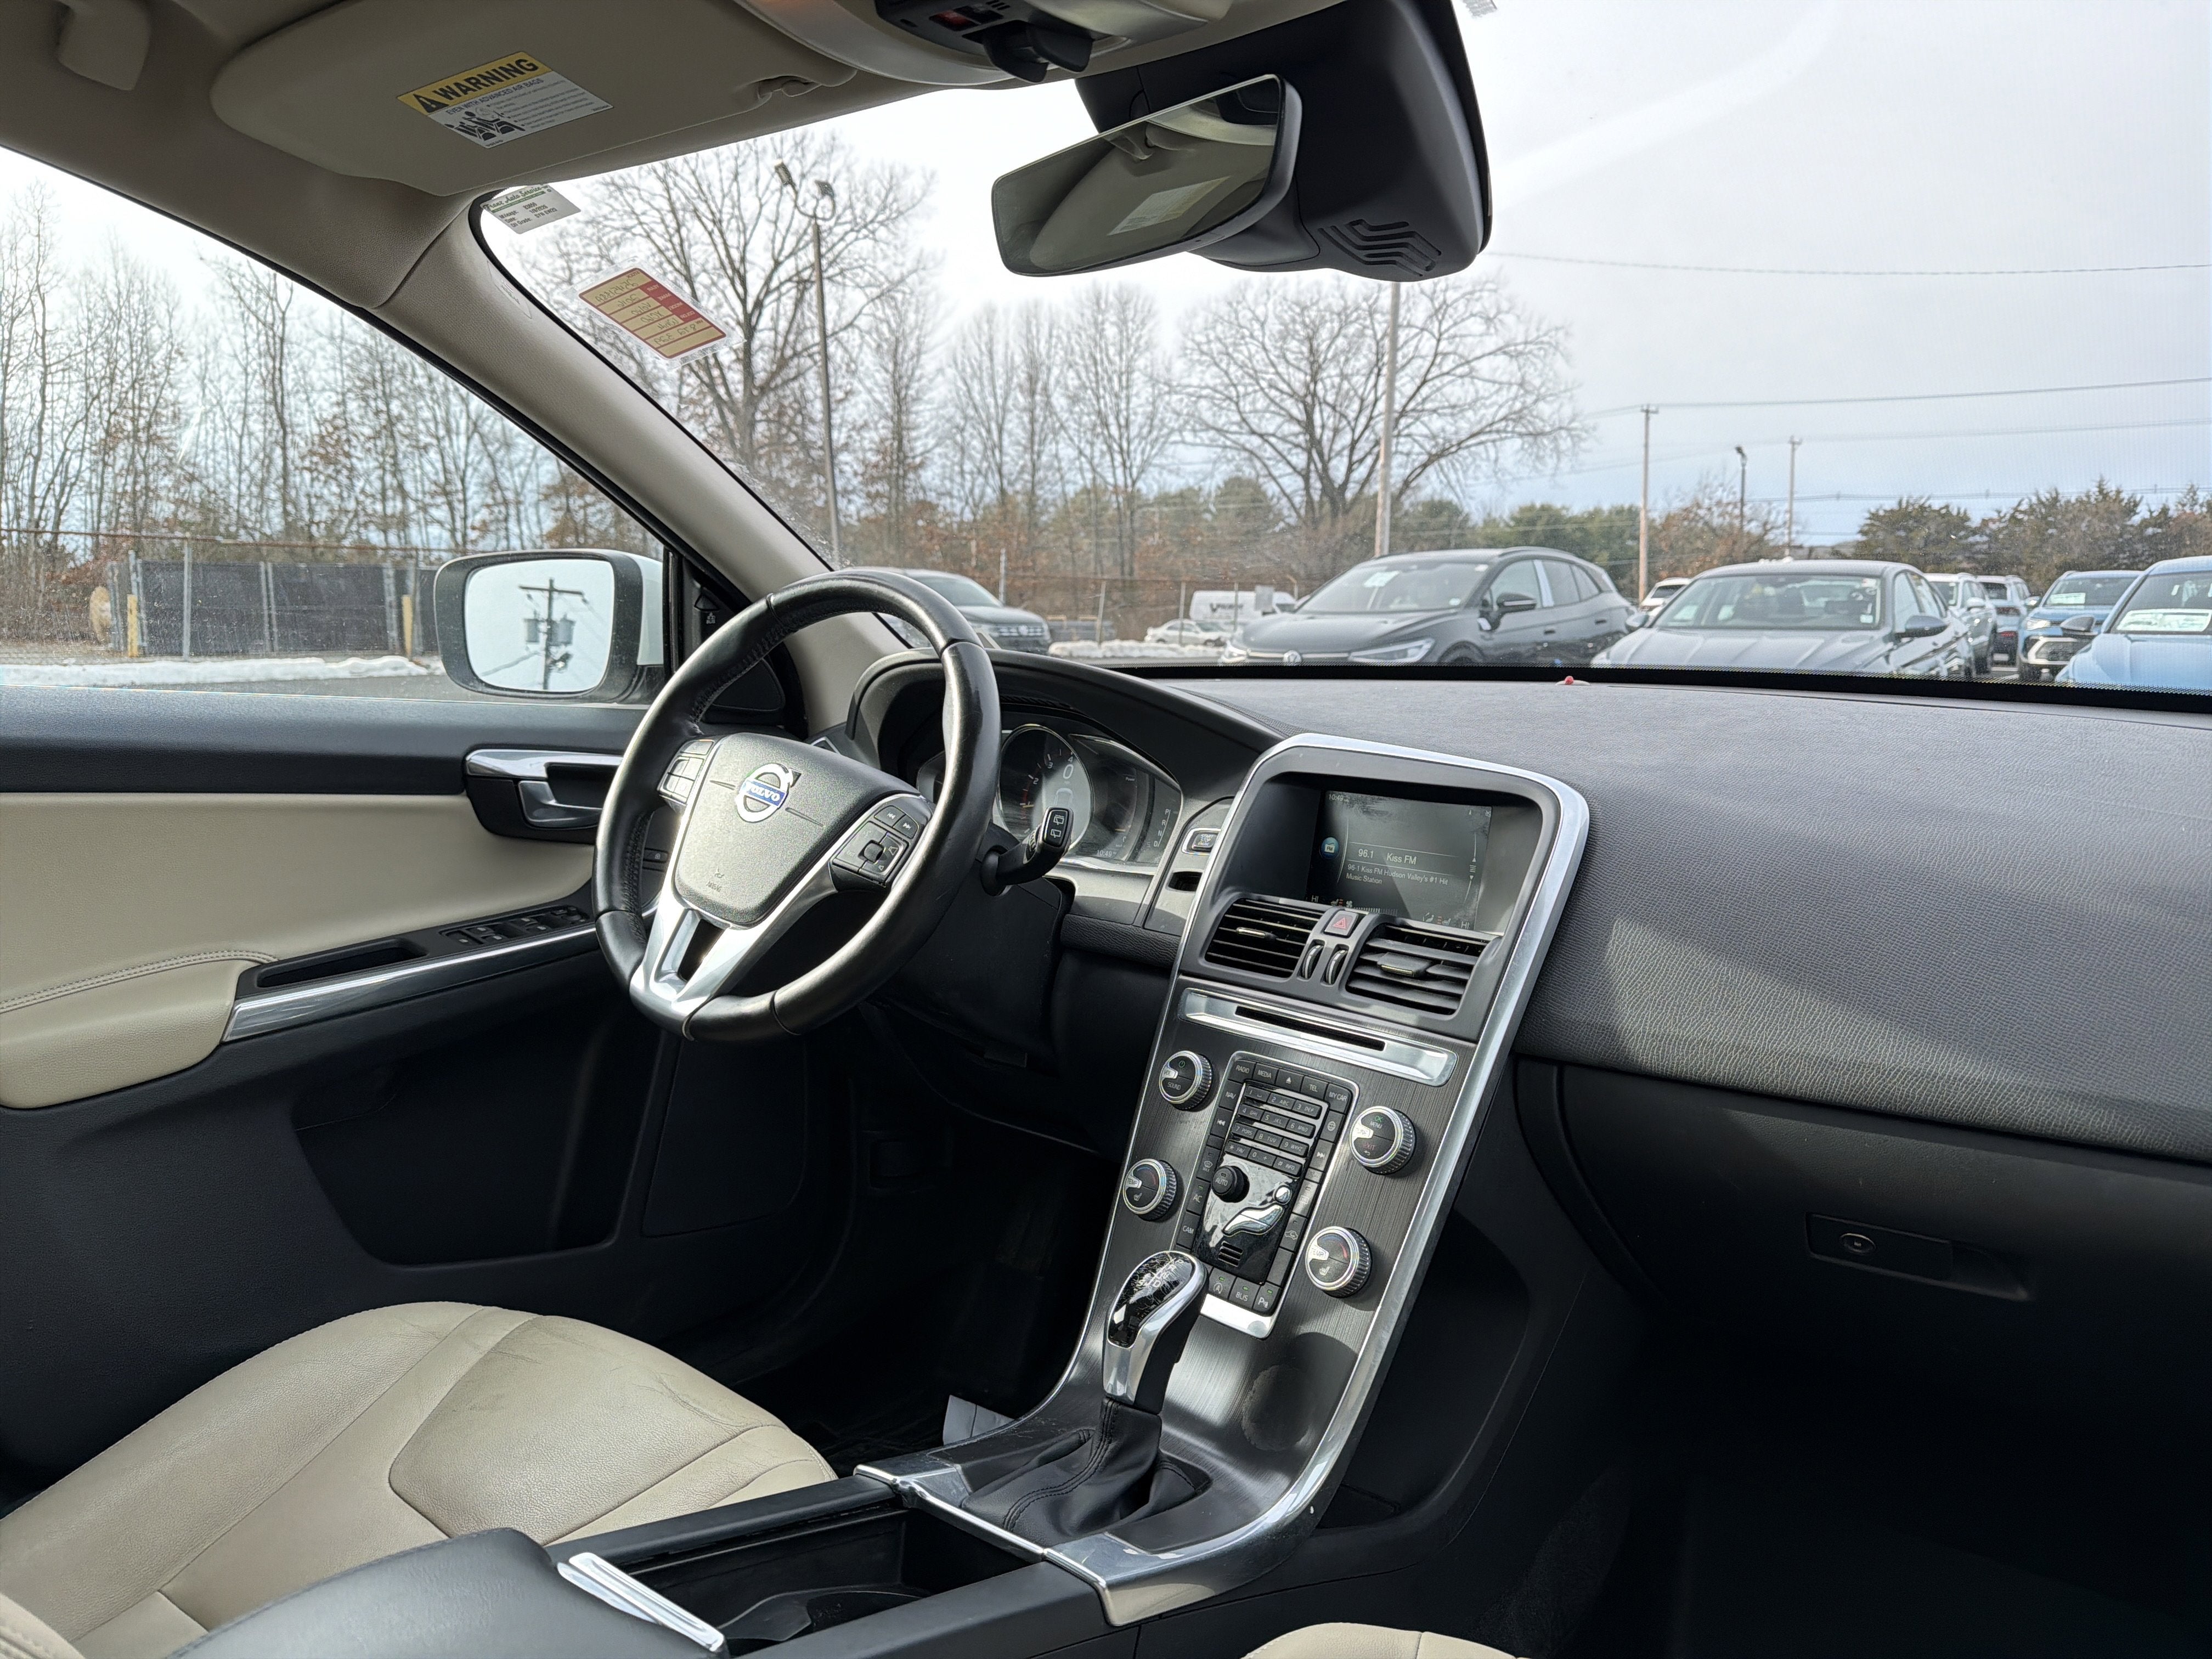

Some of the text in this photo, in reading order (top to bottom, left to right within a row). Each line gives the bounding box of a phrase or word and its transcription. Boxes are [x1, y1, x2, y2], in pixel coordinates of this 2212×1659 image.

[432, 59, 539, 100] WARNING
[445, 78, 544, 115] EVEN WITH ADVANCED AIR BAGS
[505, 195, 521, 204] Auto
[1063, 764, 1074, 779] 0
[1358, 849, 1418, 865] 96.1 Kiss FM
[1346, 872, 1383, 884] Music Station
[1361, 866, 1373, 874] Kiss
[1384, 870, 1406, 879] Hudson
[1407, 873, 1428, 883] Valley's
[1235, 1065, 1250, 1074] RADIO
[1257, 1069, 1272, 1079] MEDIA
[1167, 1081, 1181, 1091] SOUND
[1309, 1084, 1318, 1092] TEL
[1225, 1091, 1235, 1099] NAV
[1374, 1115, 1384, 1123] OK
[1369, 1121, 1383, 1129] MENU
[1215, 1177, 1228, 1186] AUTO
[1193, 1194, 1203, 1203] AC
[1182, 1225, 1194, 1234] CAM
[1235, 1292, 1249, 1302] BLIS
